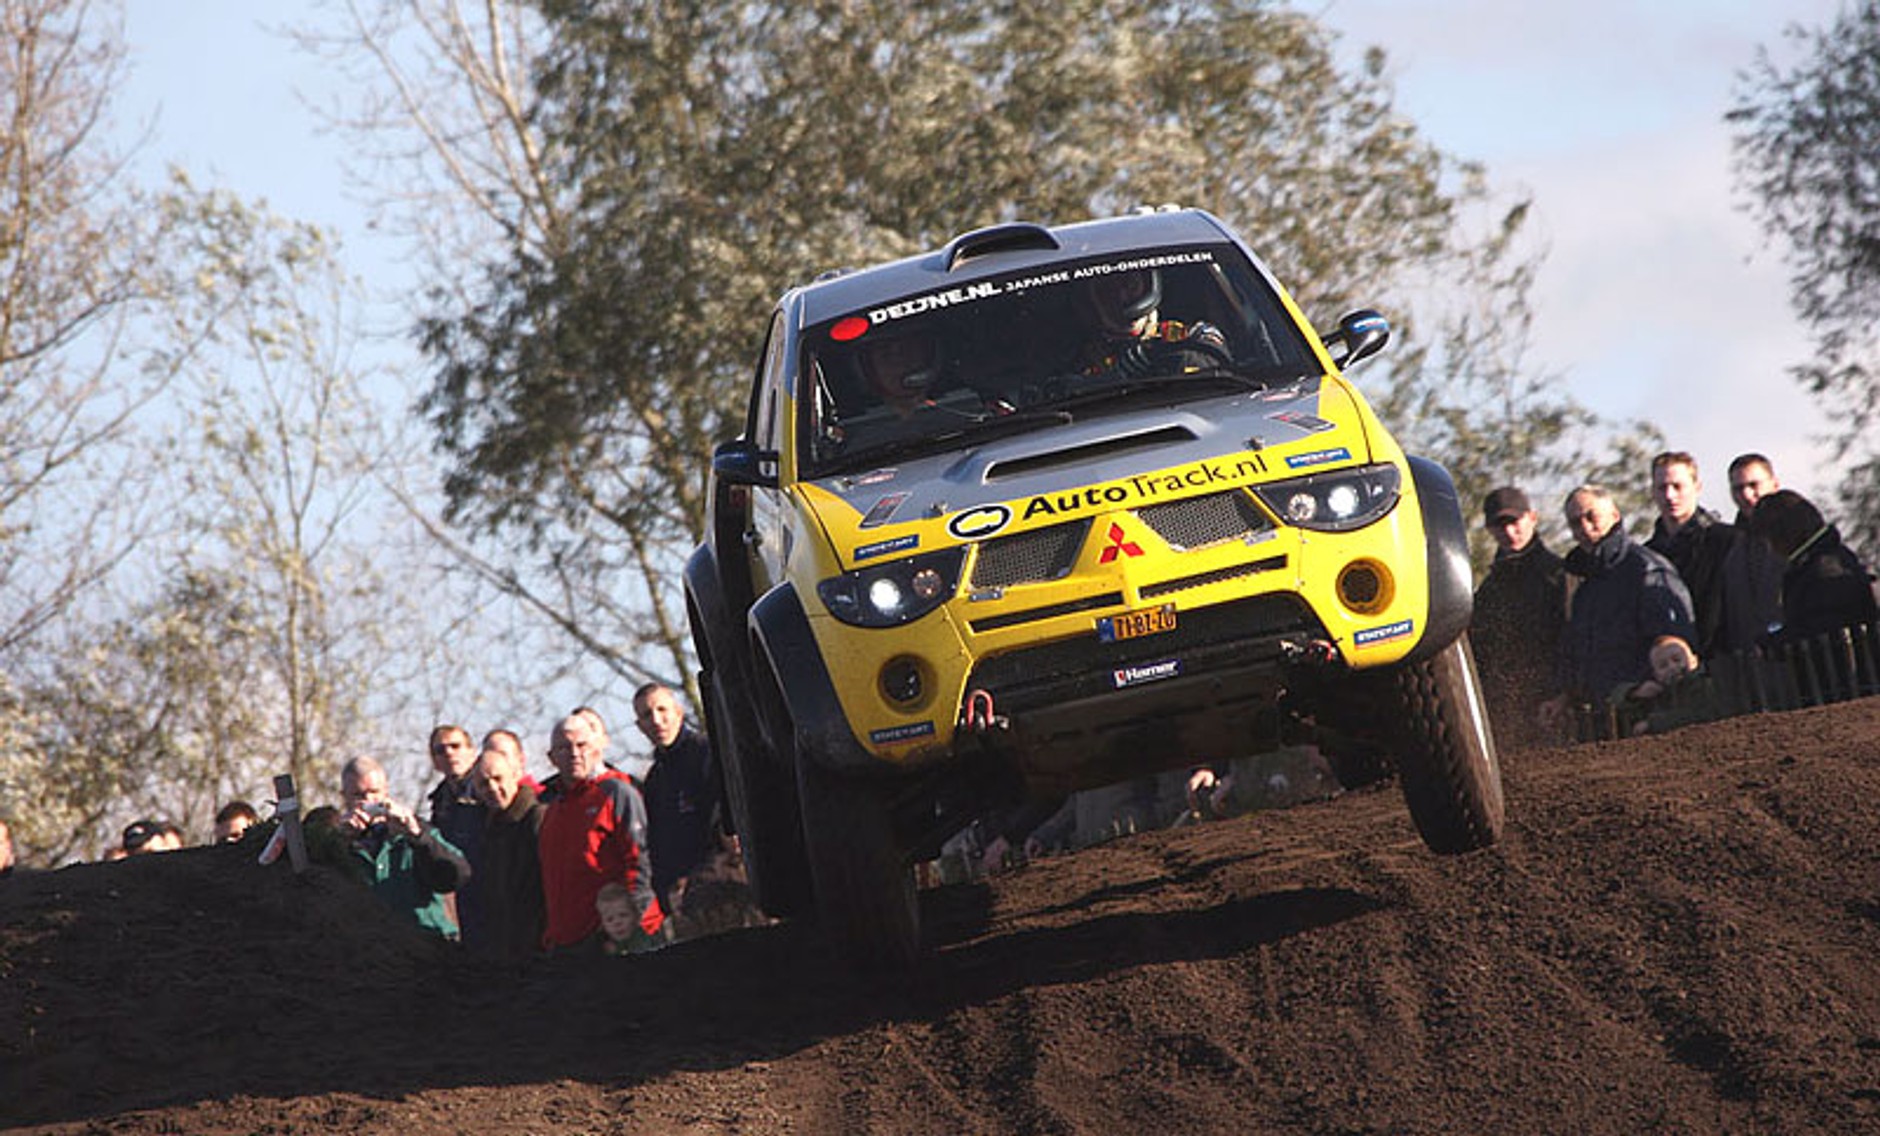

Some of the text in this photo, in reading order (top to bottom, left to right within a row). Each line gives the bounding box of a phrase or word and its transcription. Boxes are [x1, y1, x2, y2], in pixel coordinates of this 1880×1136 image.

[868, 251, 1214, 325] DEIJNE.NL JAPANSE AUTO-ONDERDELEN
[1022, 453, 1268, 520] AutoTrack.nl
